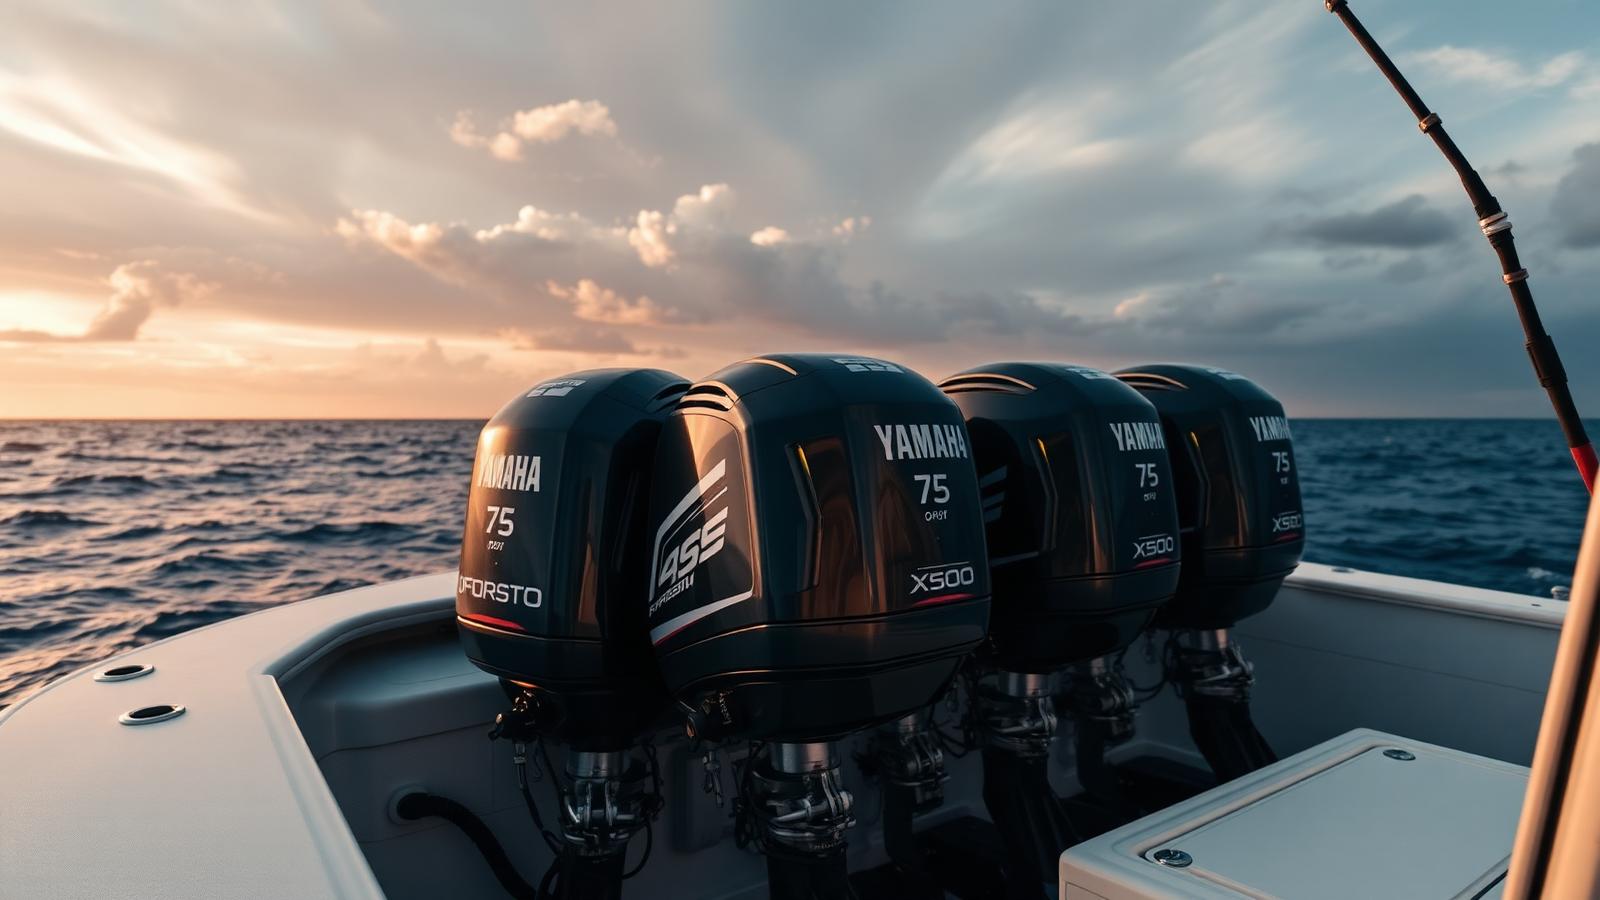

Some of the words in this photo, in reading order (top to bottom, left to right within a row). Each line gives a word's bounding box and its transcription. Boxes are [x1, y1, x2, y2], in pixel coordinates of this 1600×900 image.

[873, 424, 968, 461] YAMAHA
[1271, 452, 1290, 472] 75
[914, 474, 950, 505] 75
[1135, 464, 1159, 488] 75
[486, 506, 515, 537] 75
[1132, 536, 1174, 559] X500
[910, 567, 974, 594] X500
